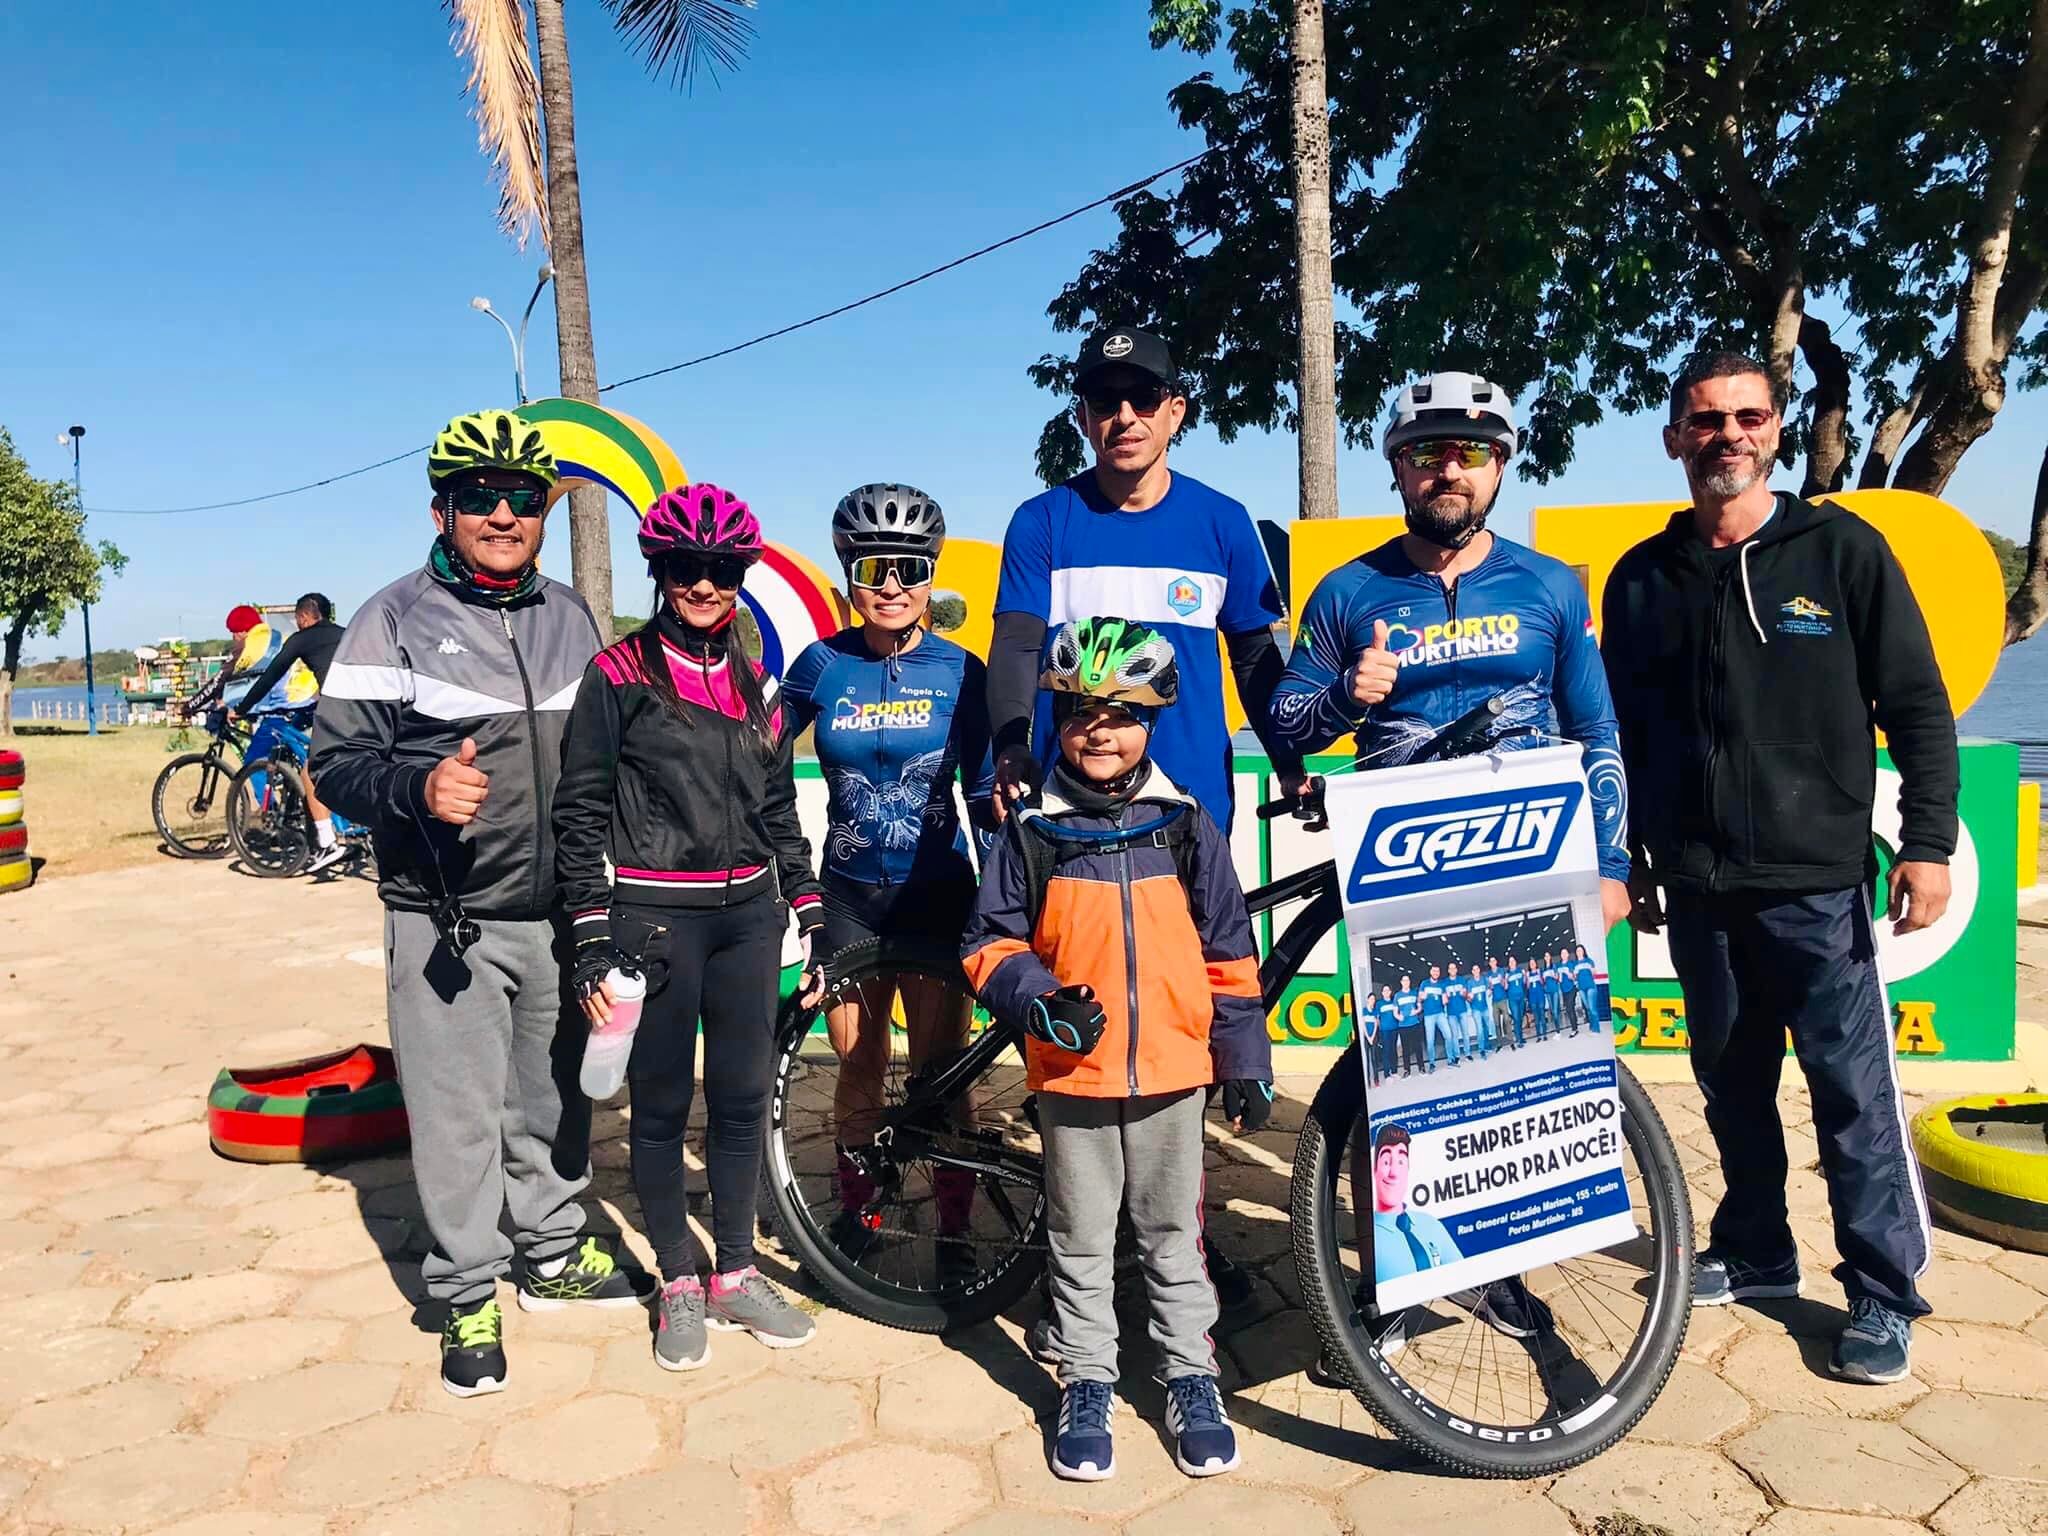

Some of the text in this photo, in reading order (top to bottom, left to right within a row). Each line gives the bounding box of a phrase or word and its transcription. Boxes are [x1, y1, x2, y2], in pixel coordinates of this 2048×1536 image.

[1424, 614, 1520, 645] PORTO
[900, 686, 933, 697] Angela
[831, 712, 931, 731] MURTINHO
[862, 699, 932, 716] PORTO
[1364, 795, 1568, 880] GAZIN
[1445, 1098, 1616, 1161] SEMPRE FAZENDO
[1412, 1128, 1617, 1207] O MELHOR PRA VOCÊ!
[1457, 1225, 1474, 1236] Rua
[1475, 1213, 1508, 1230] General
[1510, 1205, 1541, 1221] Cândido
[1575, 1189, 1590, 1200] 155
[1595, 1182, 1619, 1194] Centro
[1508, 1225, 1531, 1236] Porto
[1532, 1213, 1565, 1229] Murtinho
[1571, 1206, 1584, 1217] MS
[1448, 1417, 1552, 1443] aero
